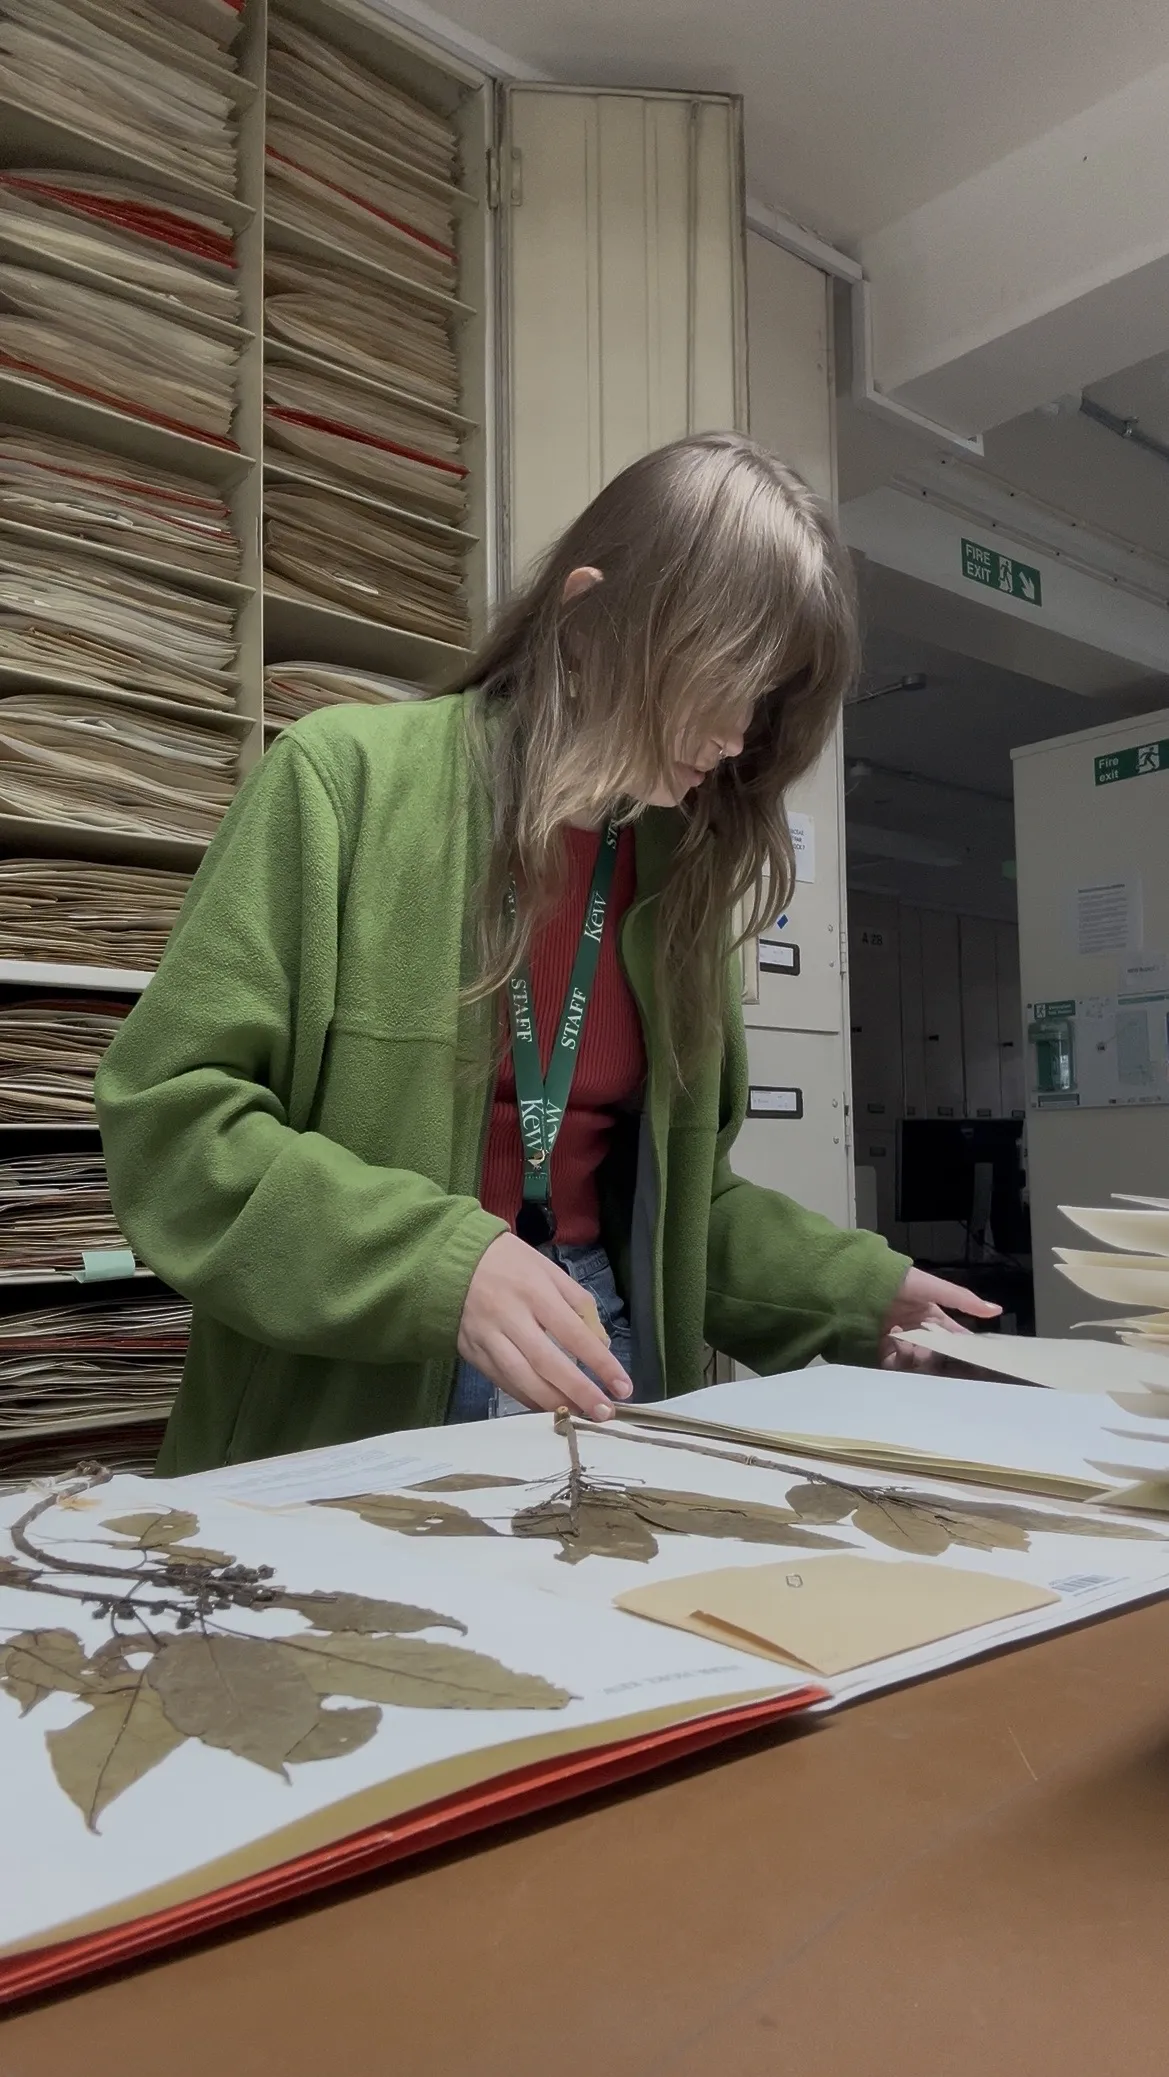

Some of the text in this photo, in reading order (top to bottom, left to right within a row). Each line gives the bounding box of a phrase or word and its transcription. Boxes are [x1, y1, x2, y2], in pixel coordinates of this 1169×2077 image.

[966, 543, 991, 566] FIRE
[967, 561, 992, 583] EXIT
[1099, 757, 1119, 769] Fire
[1099, 769, 1119, 782] exit
[583, 889, 607, 944] Kew
[511, 978, 533, 1043] STAFF
[561, 987, 587, 1050] STAFF
[520, 1098, 545, 1151] Kew
